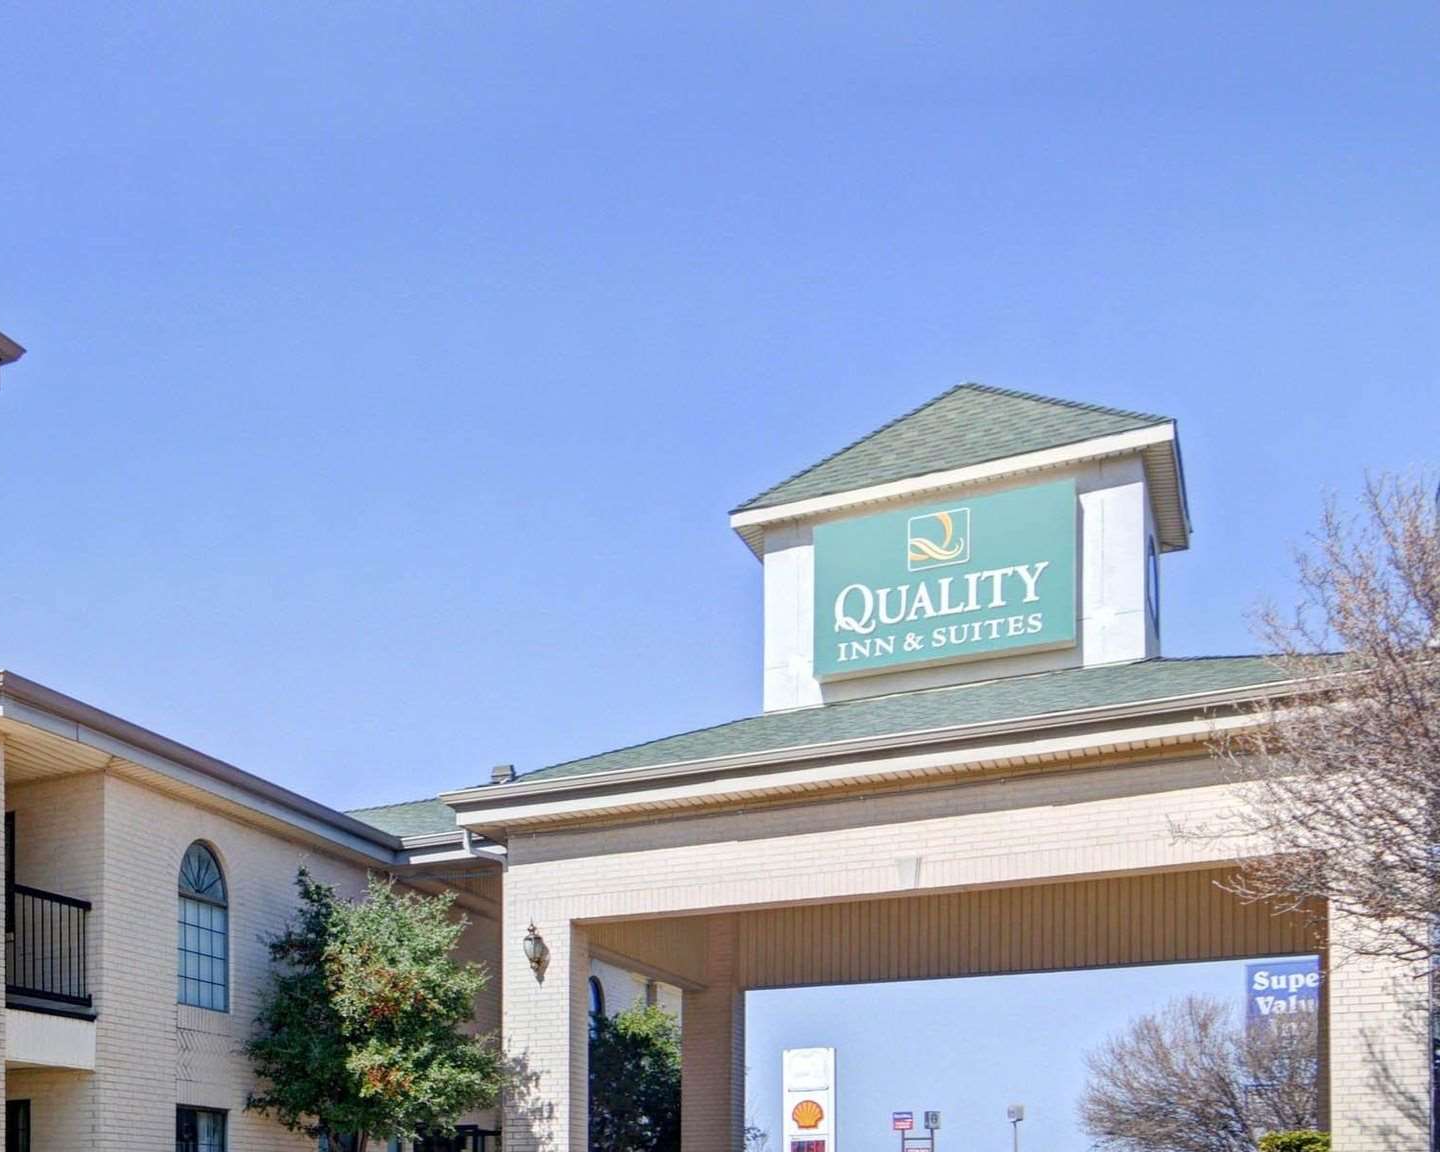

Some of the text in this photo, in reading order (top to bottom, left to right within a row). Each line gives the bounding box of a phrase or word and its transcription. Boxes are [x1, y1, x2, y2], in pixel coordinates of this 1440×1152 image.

[834, 561, 1049, 635] QUALITY
[837, 612, 1043, 662] INN & SUITES
